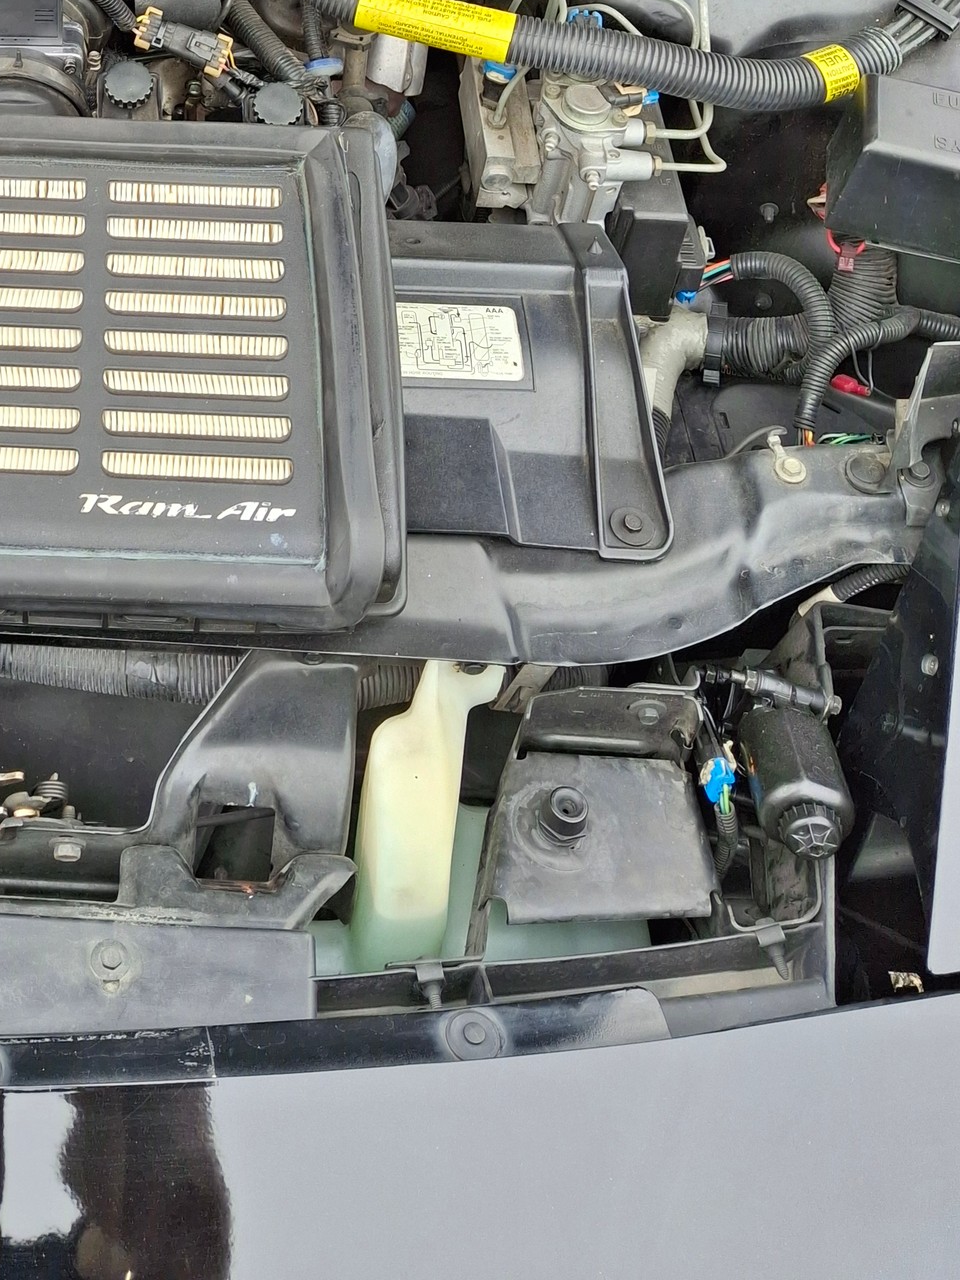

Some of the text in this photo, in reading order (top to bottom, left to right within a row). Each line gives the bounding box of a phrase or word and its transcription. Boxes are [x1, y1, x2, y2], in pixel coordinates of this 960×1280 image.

[422, 9, 450, 19] CAUTION
[819, 52, 849, 67] FUEL
[78, 493, 297, 522] Ram Air
